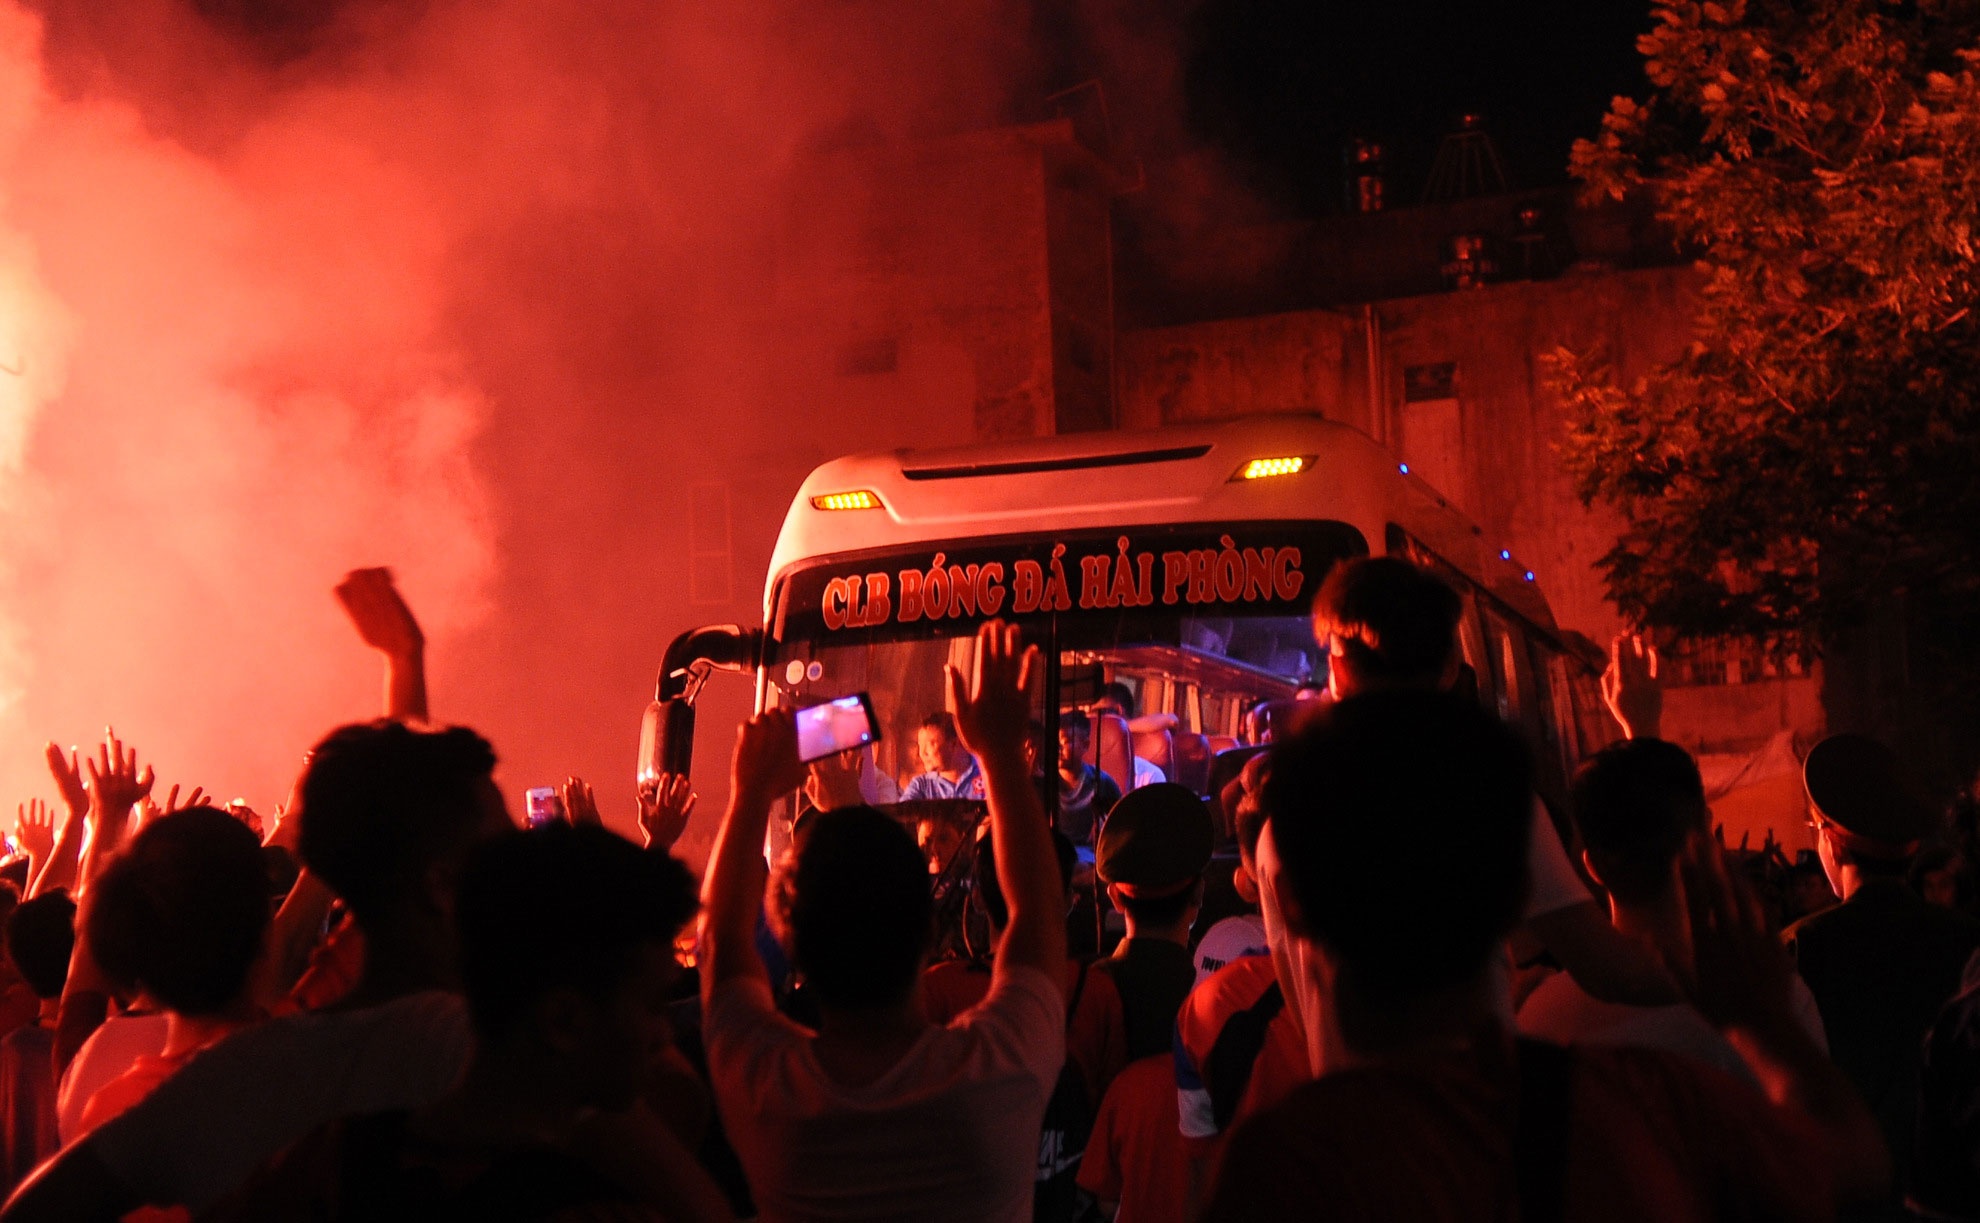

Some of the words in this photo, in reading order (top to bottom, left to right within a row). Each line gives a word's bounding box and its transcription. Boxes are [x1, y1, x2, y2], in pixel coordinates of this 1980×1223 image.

[822, 572, 890, 630] CLB
[897, 552, 1005, 622] BÓNG
[1013, 543, 1071, 613] ĐÁ
[1079, 536, 1154, 609] HẢI
[1162, 534, 1304, 604] PHÒNG
